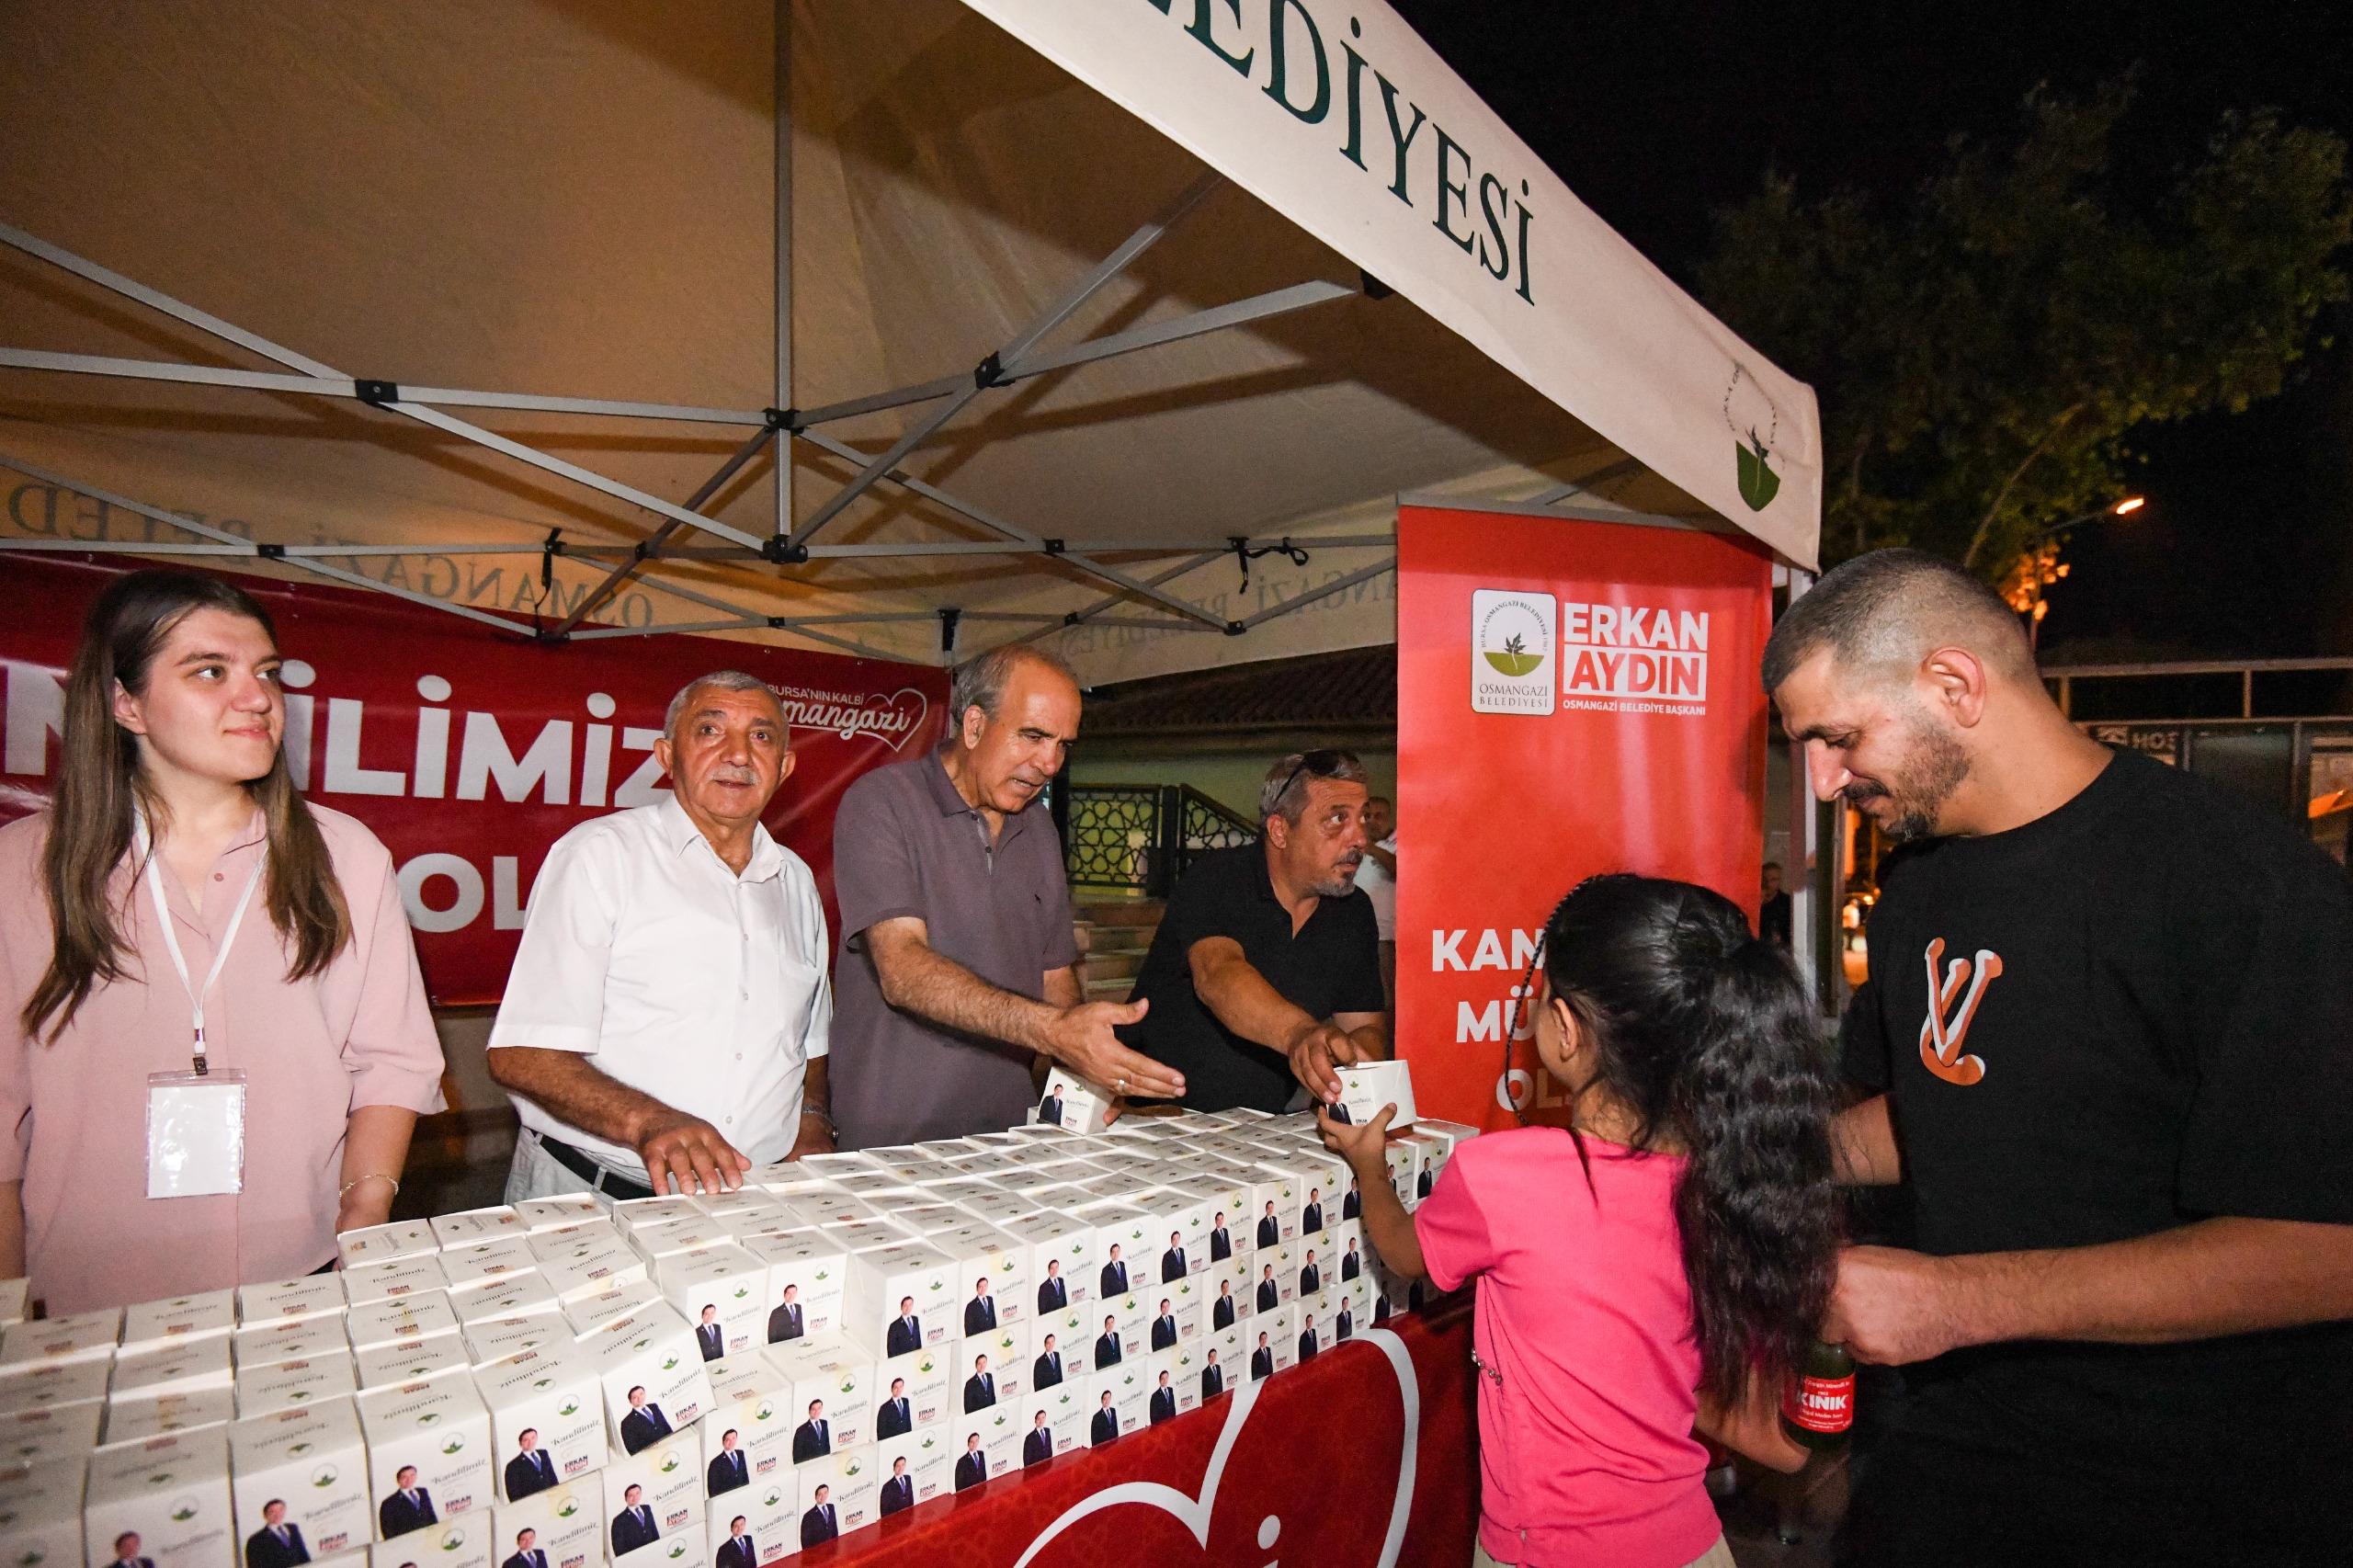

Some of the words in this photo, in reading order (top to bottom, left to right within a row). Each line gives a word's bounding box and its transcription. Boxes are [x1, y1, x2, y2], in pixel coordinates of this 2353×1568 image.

[1146, 0, 1535, 306] EDİYESİ
[1563, 603, 1709, 651] ERKAN
[1569, 650, 1700, 697] AYDIN
[1479, 683, 1548, 697] OSMANGAZİ
[832, 692, 866, 706] KALBİ
[1480, 696, 1548, 708] BELEDİYESİ
[1563, 699, 1618, 711] OSMANGAZİ
[1620, 701, 1664, 713] BELEDİYE
[1665, 705, 1706, 717] BAŞKANI
[782, 699, 912, 741] mangazi
[397, 853, 528, 934] OL
[1432, 928, 1546, 971] KAN
[1456, 984, 1538, 1043] MÜ
[1496, 1068, 1564, 1112] OL
[676, 1403, 697, 1416] ERKAN
[838, 1428, 857, 1439] ERKAN
[564, 1455, 588, 1469] ERKAN
[756, 1456, 777, 1468] ERKAN
[666, 1508, 688, 1521] ERKAN
[846, 1510, 863, 1521] ERKAN
[764, 1542, 782, 1554] ERKAN
